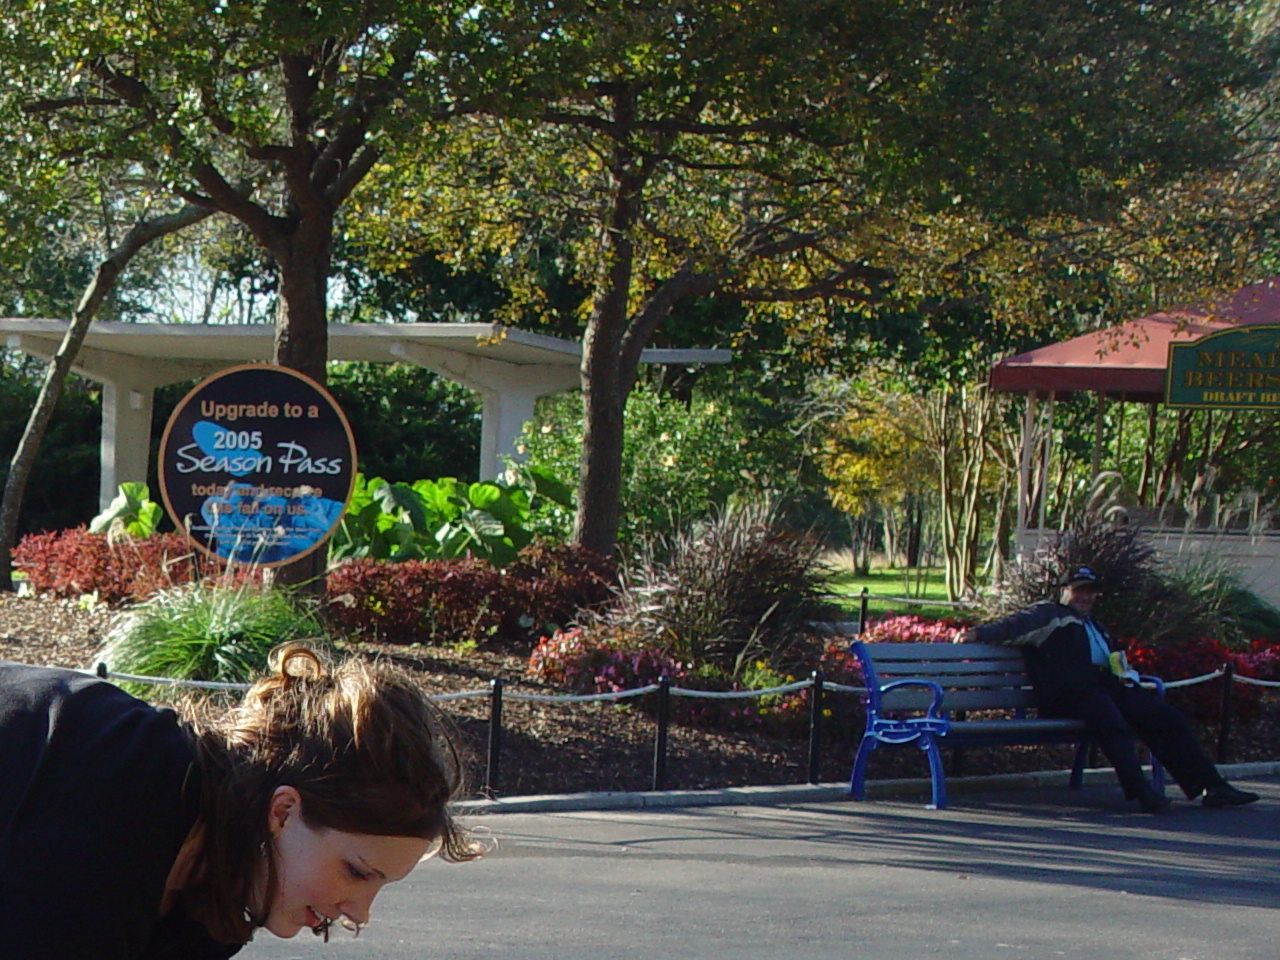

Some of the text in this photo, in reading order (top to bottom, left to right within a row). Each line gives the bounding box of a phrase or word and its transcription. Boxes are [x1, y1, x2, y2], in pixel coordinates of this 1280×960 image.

[1203, 391, 1256, 402] DRAFT
[201, 401, 319, 420] Upgrade to a
[213, 431, 263, 449] 2005
[176, 440, 343, 474] Season Pass
[263, 504, 282, 515] on
